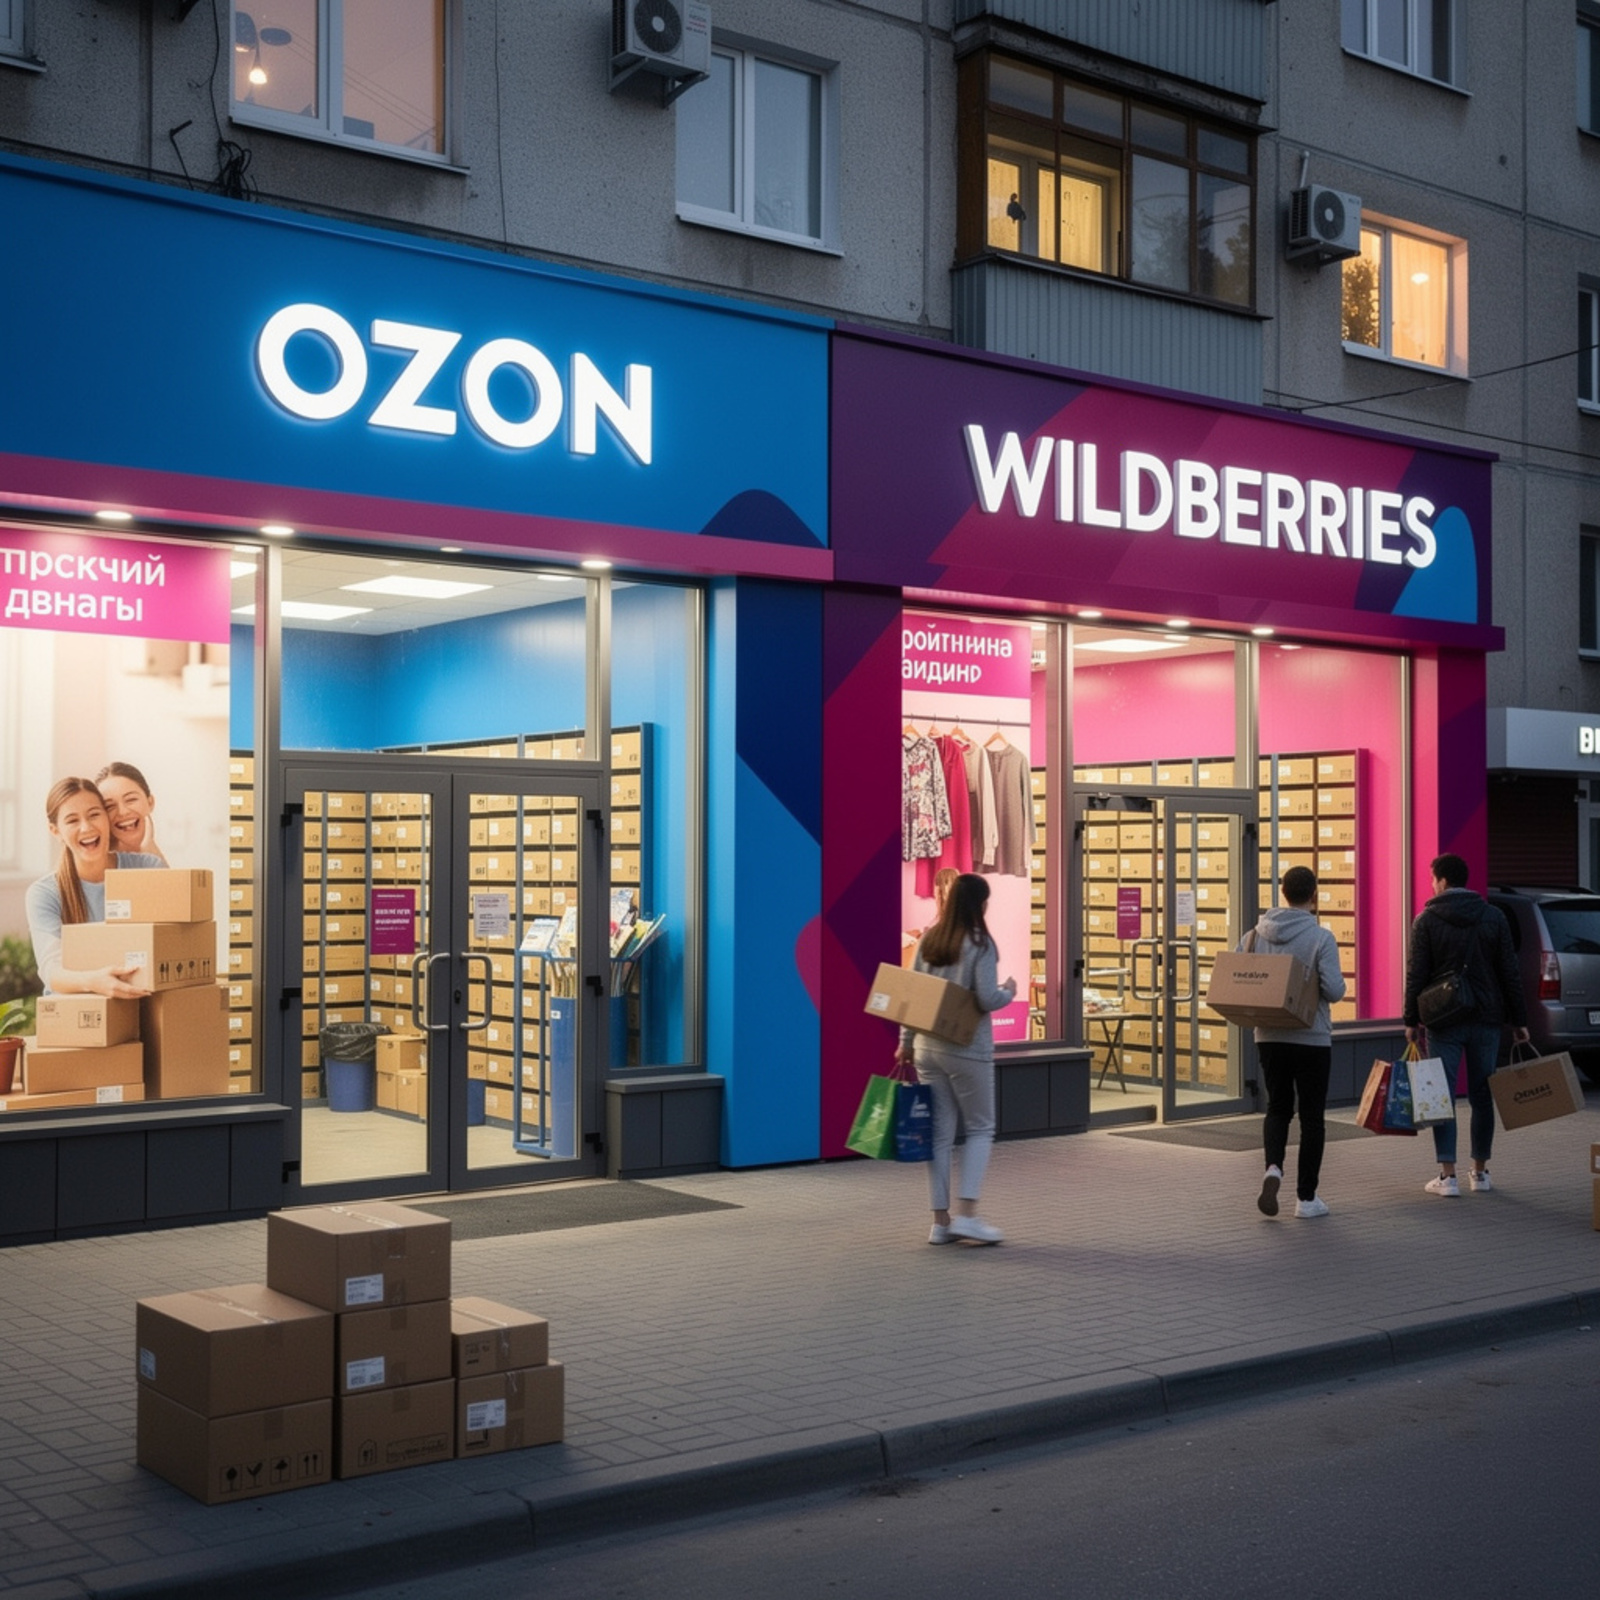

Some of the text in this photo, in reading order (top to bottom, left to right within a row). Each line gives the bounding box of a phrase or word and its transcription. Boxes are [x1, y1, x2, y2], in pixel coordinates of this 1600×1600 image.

[256, 303, 652, 465] OZON
[964, 424, 1437, 568] WILDBERRIES
[5, 588, 143, 622] двнагы
